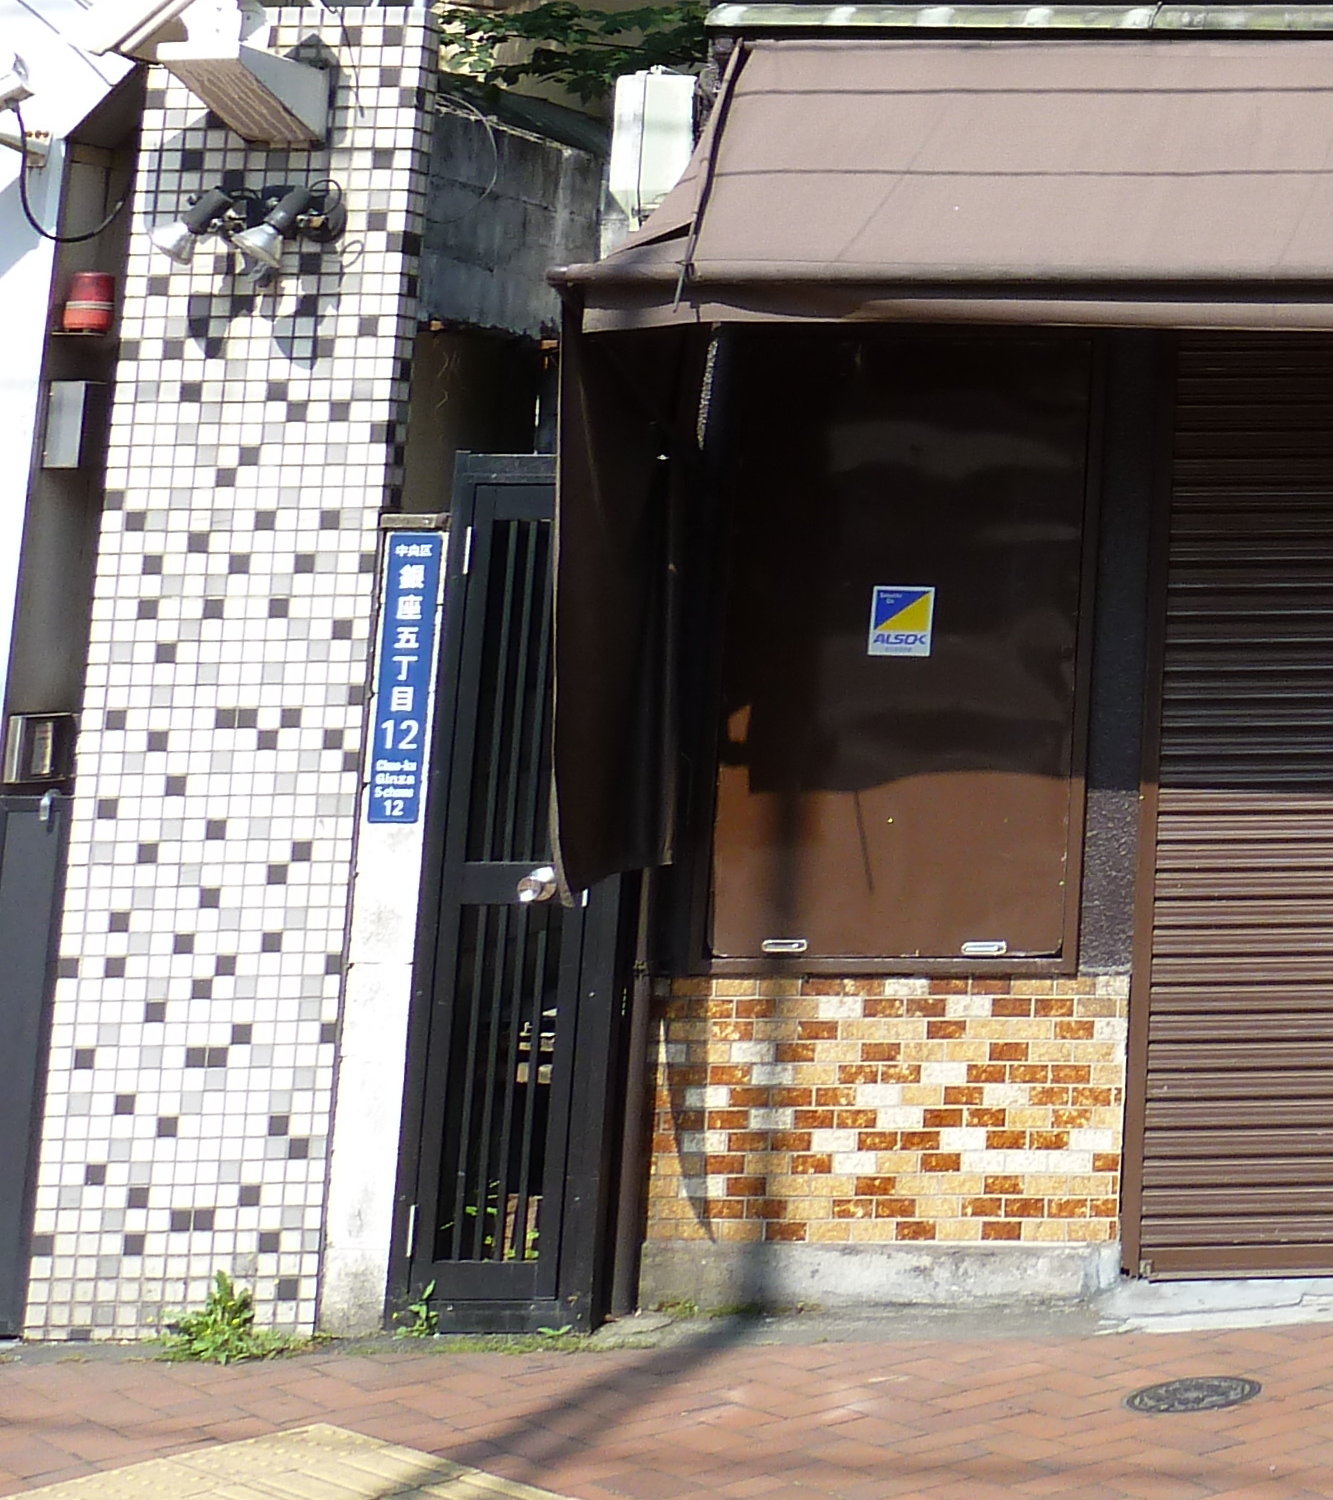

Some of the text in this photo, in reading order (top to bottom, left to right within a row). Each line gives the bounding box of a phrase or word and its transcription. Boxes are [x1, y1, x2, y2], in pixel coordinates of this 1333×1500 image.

[395, 544, 433, 557] 中央区
[390, 564, 425, 712] 銀座五丁目
[873, 633, 927, 645] ALSOK
[381, 719, 419, 750] 12
[375, 773, 415, 785] Ginza
[374, 786, 414, 798] 5-chome
[383, 799, 404, 816] 12
